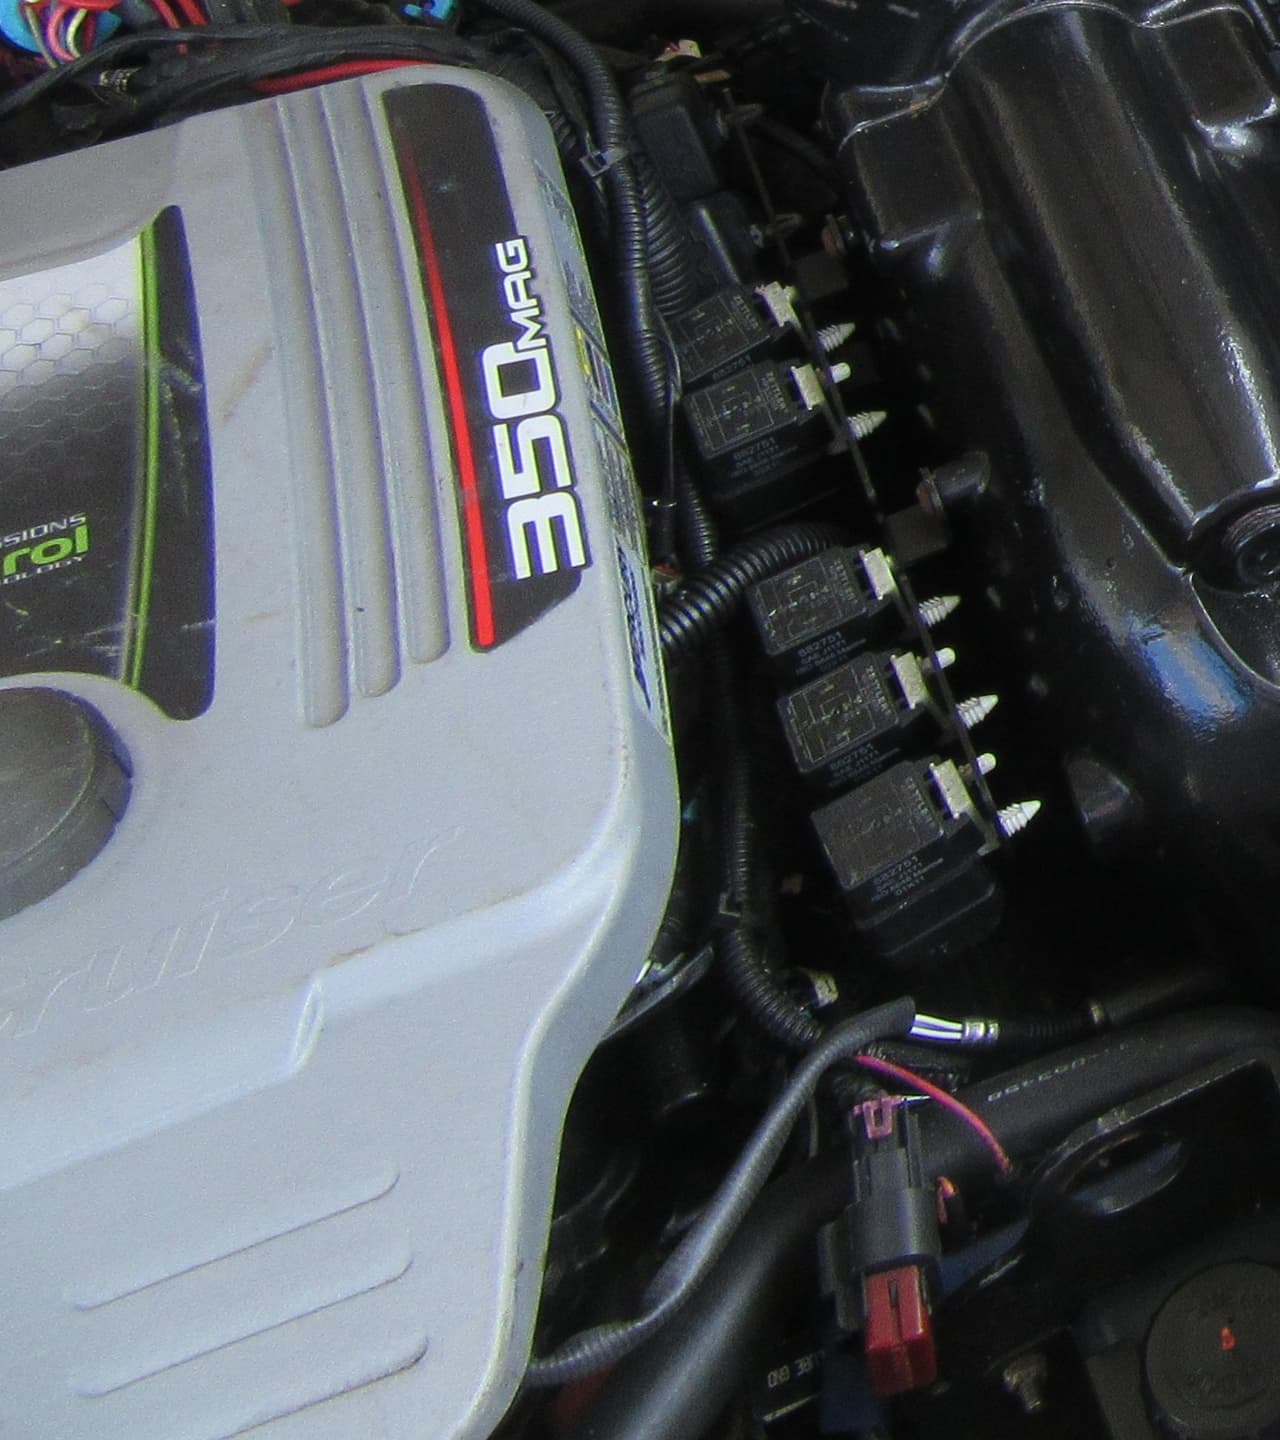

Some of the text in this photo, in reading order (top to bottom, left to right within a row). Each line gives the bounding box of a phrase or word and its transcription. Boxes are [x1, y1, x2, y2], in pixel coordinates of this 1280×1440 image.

[482, 237, 587, 581] 350 MAG
[3, 524, 90, 577] rol
